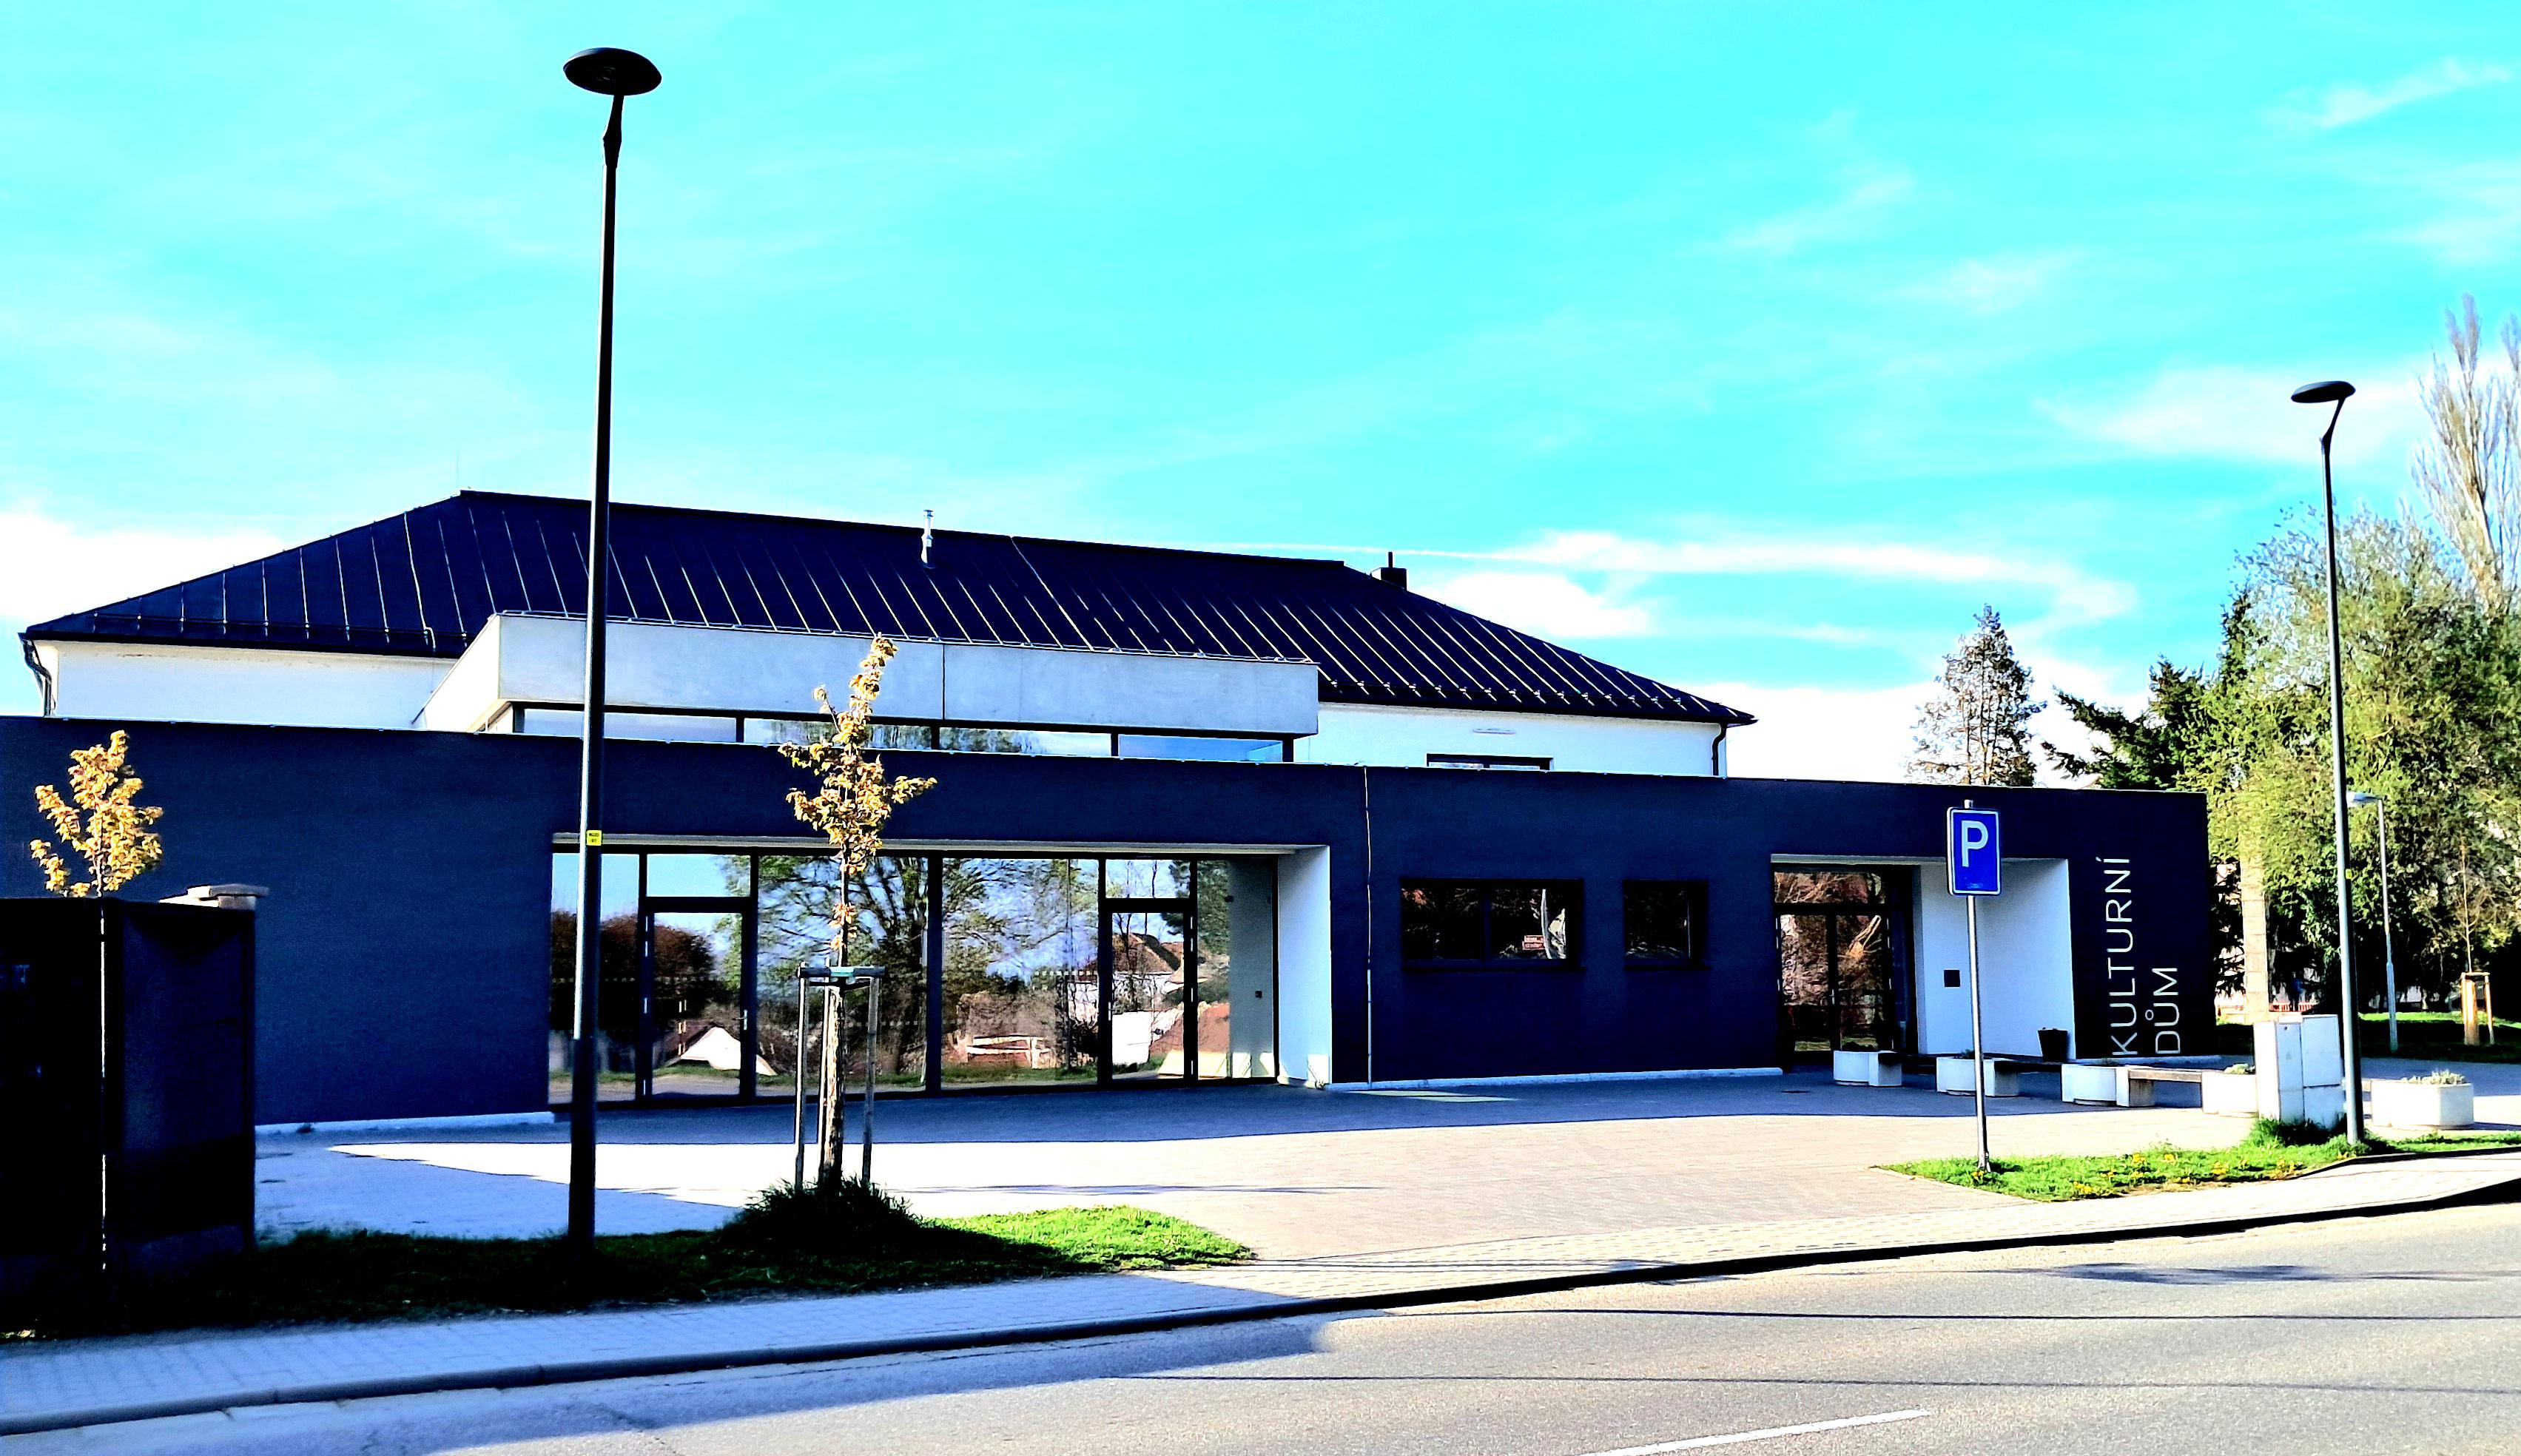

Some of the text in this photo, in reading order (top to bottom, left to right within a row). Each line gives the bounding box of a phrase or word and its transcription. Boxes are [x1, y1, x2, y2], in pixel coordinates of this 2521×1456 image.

[1961, 820, 1988, 867] P
[2096, 857, 2138, 1055] KULTURNÍ
[2145, 968, 2181, 1054] DŮM
